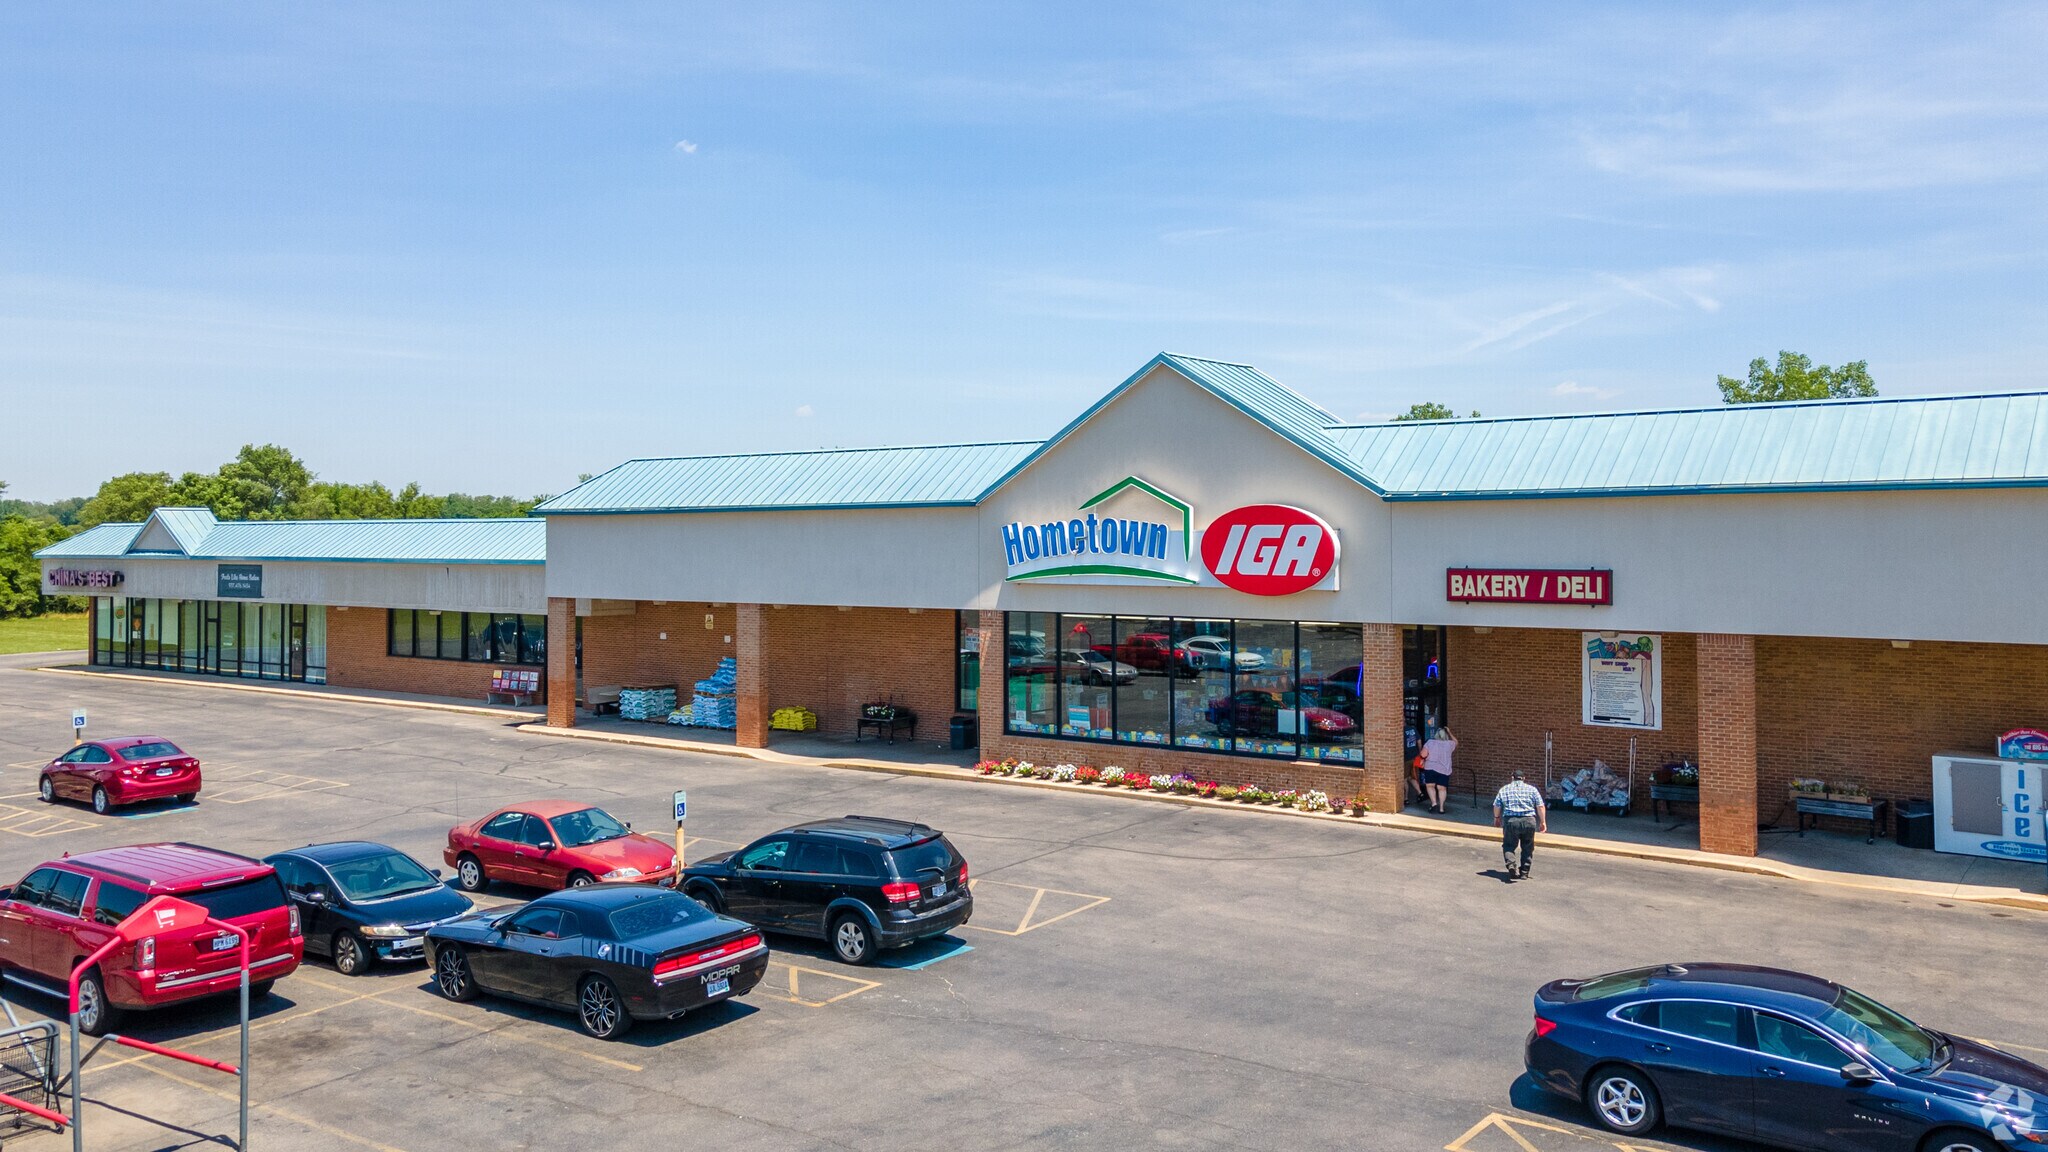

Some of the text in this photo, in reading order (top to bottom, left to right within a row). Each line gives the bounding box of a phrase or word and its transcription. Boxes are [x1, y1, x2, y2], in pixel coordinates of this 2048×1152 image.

[1002, 513, 1168, 566] Hometown
[1214, 524, 1323, 576] IGA
[48, 568, 115, 587] CHINA'S BEST
[1451, 575, 1602, 599] BAKERY / DELI
[700, 964, 741, 985] MOPAR
[1853, 1113, 1890, 1125] MALIBU
